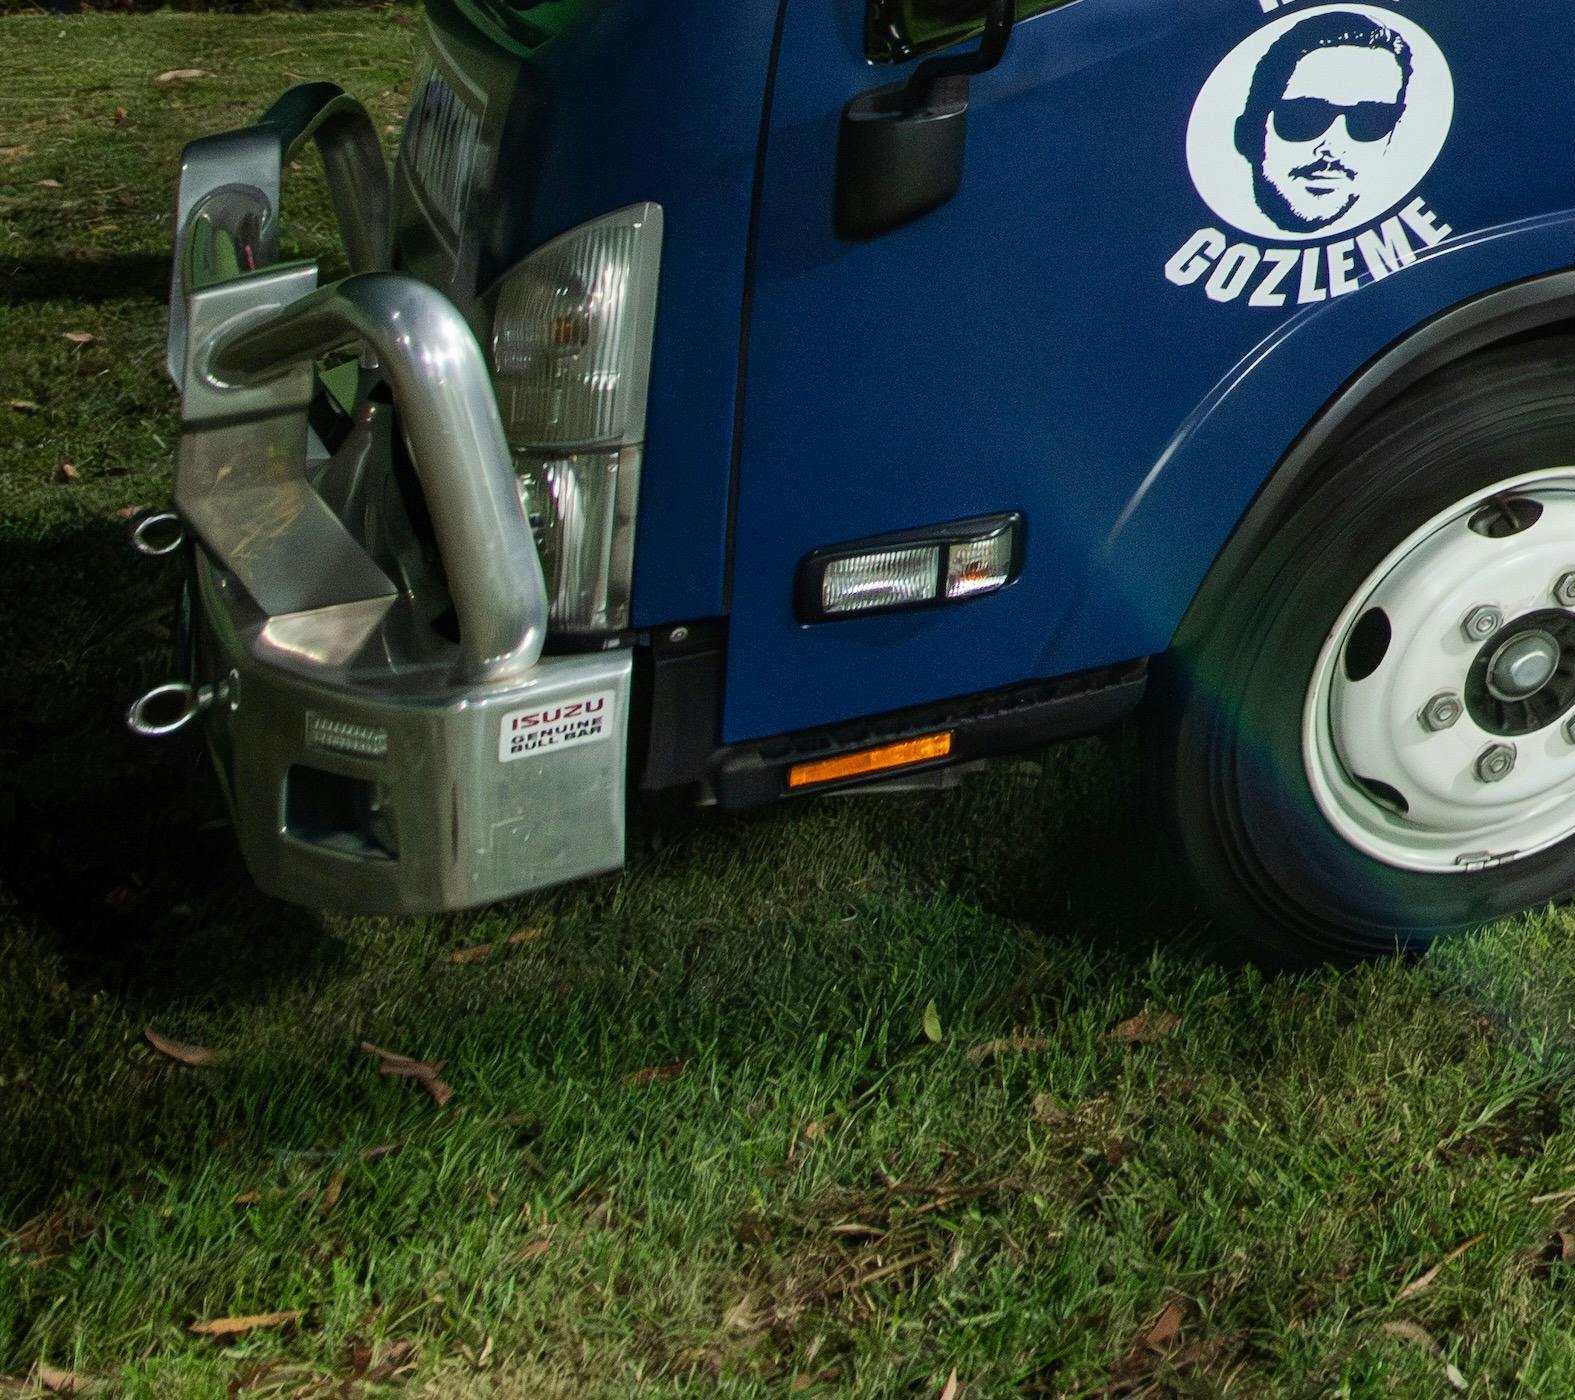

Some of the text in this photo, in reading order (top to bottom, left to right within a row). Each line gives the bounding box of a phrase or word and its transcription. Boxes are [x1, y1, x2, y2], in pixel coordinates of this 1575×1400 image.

[1163, 196, 1453, 308] GOZLEME
[511, 716, 604, 745] GENUINE
[512, 698, 604, 732] ISUZU
[511, 726, 602, 754] BULL BAR
